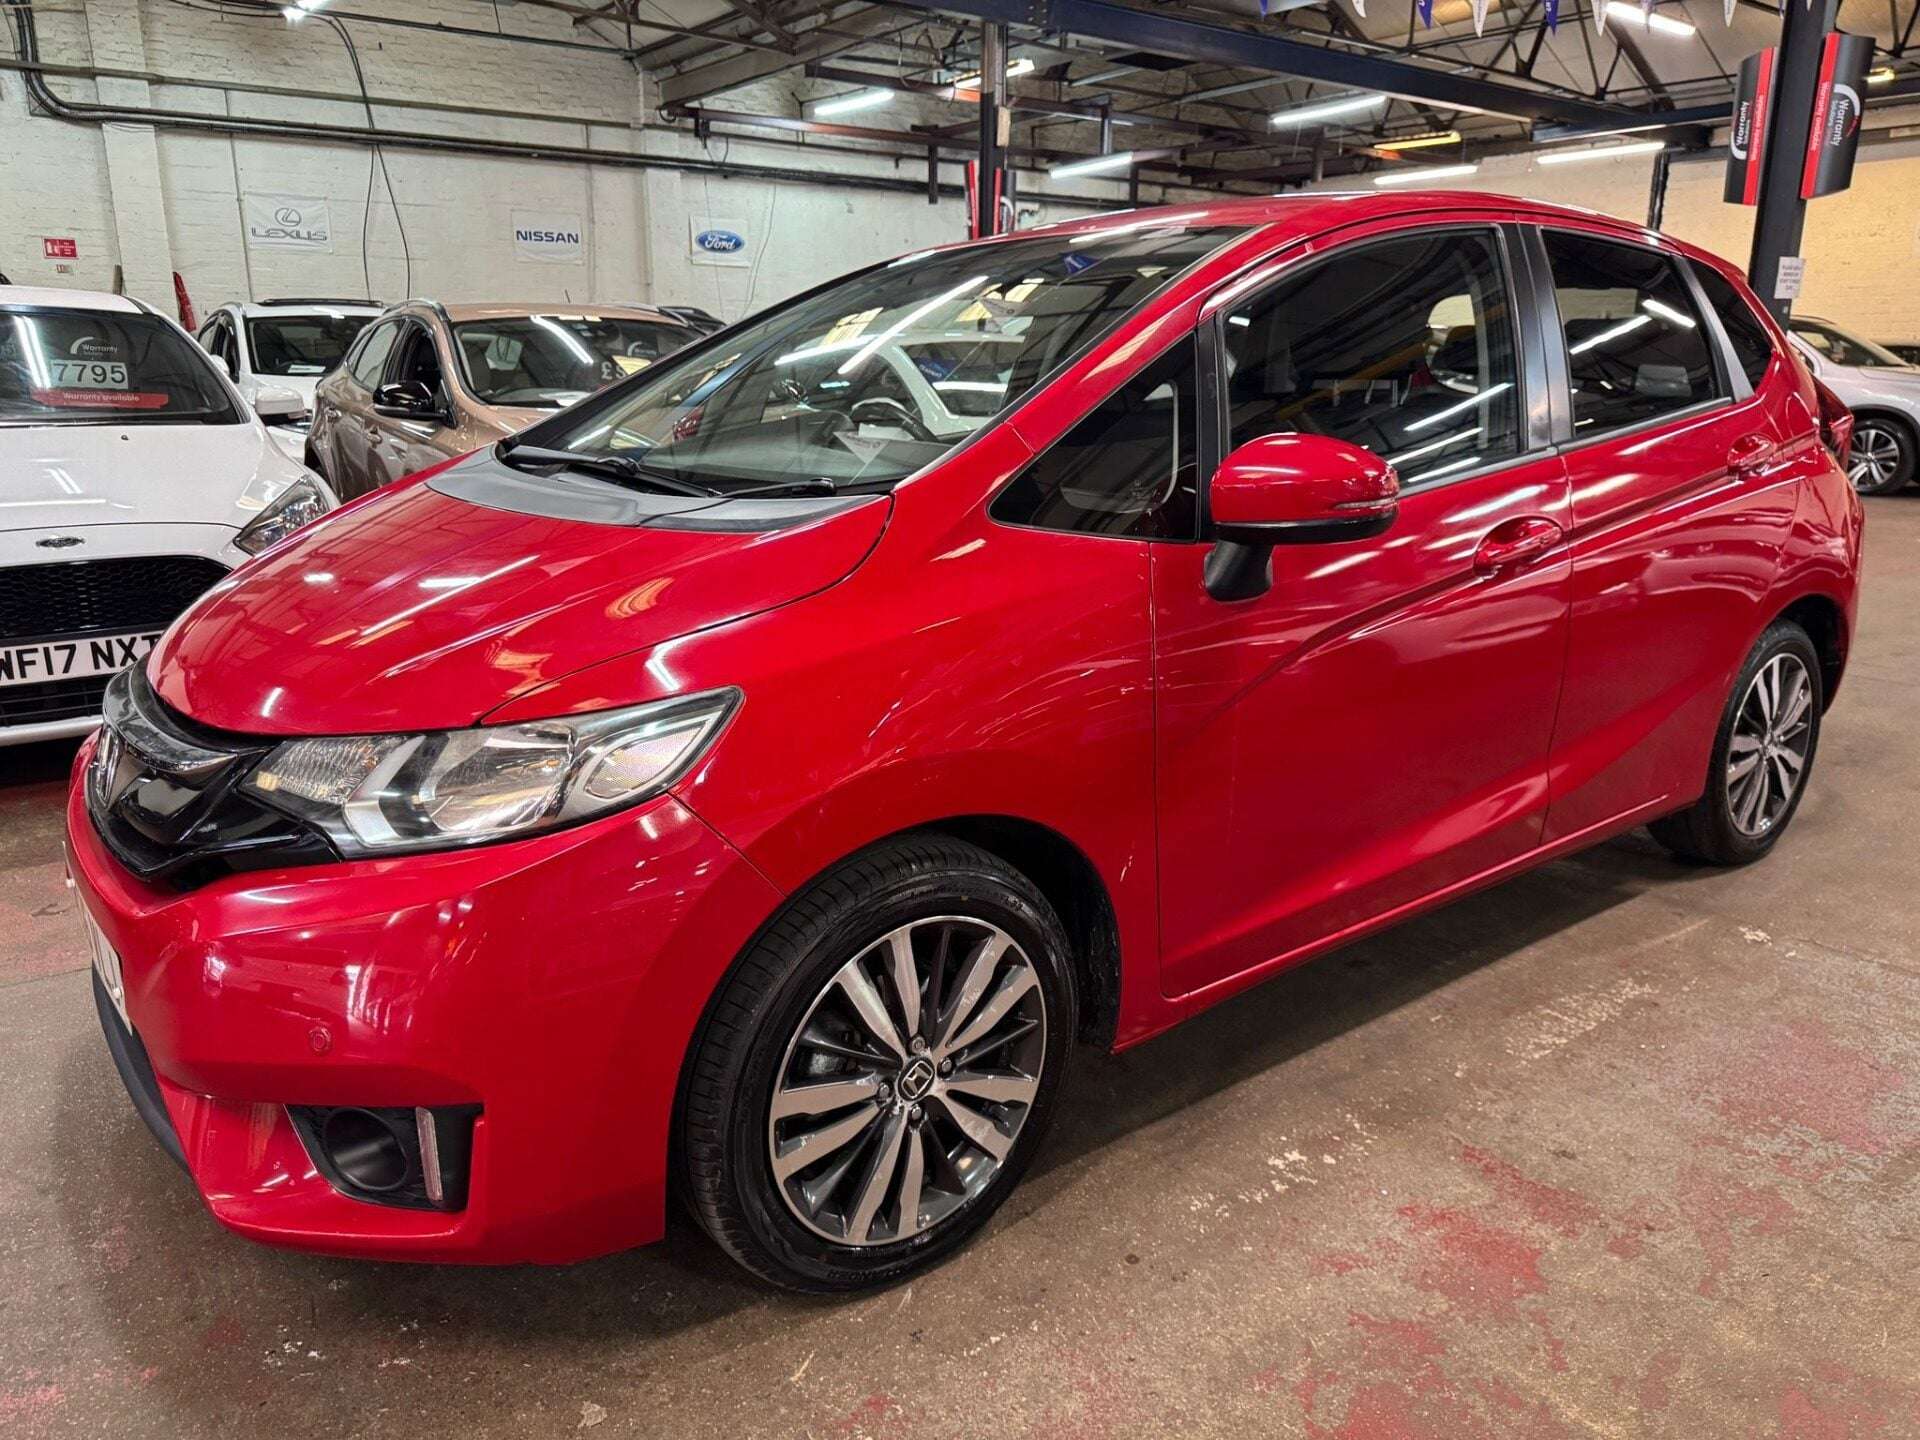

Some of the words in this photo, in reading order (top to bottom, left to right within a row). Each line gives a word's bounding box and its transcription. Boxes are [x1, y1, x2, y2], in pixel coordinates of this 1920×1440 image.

[1735, 101, 1750, 146] Warranty
[1830, 99, 1849, 146] Warranty
[251, 227, 327, 241] LEXUS
[516, 230, 579, 243] NISSAN
[705, 234, 736, 250] Ford
[81, 343, 118, 353] Warranty
[53, 363, 126, 384] 7795
[63, 391, 101, 401] Warranty
[102, 393, 139, 402] available
